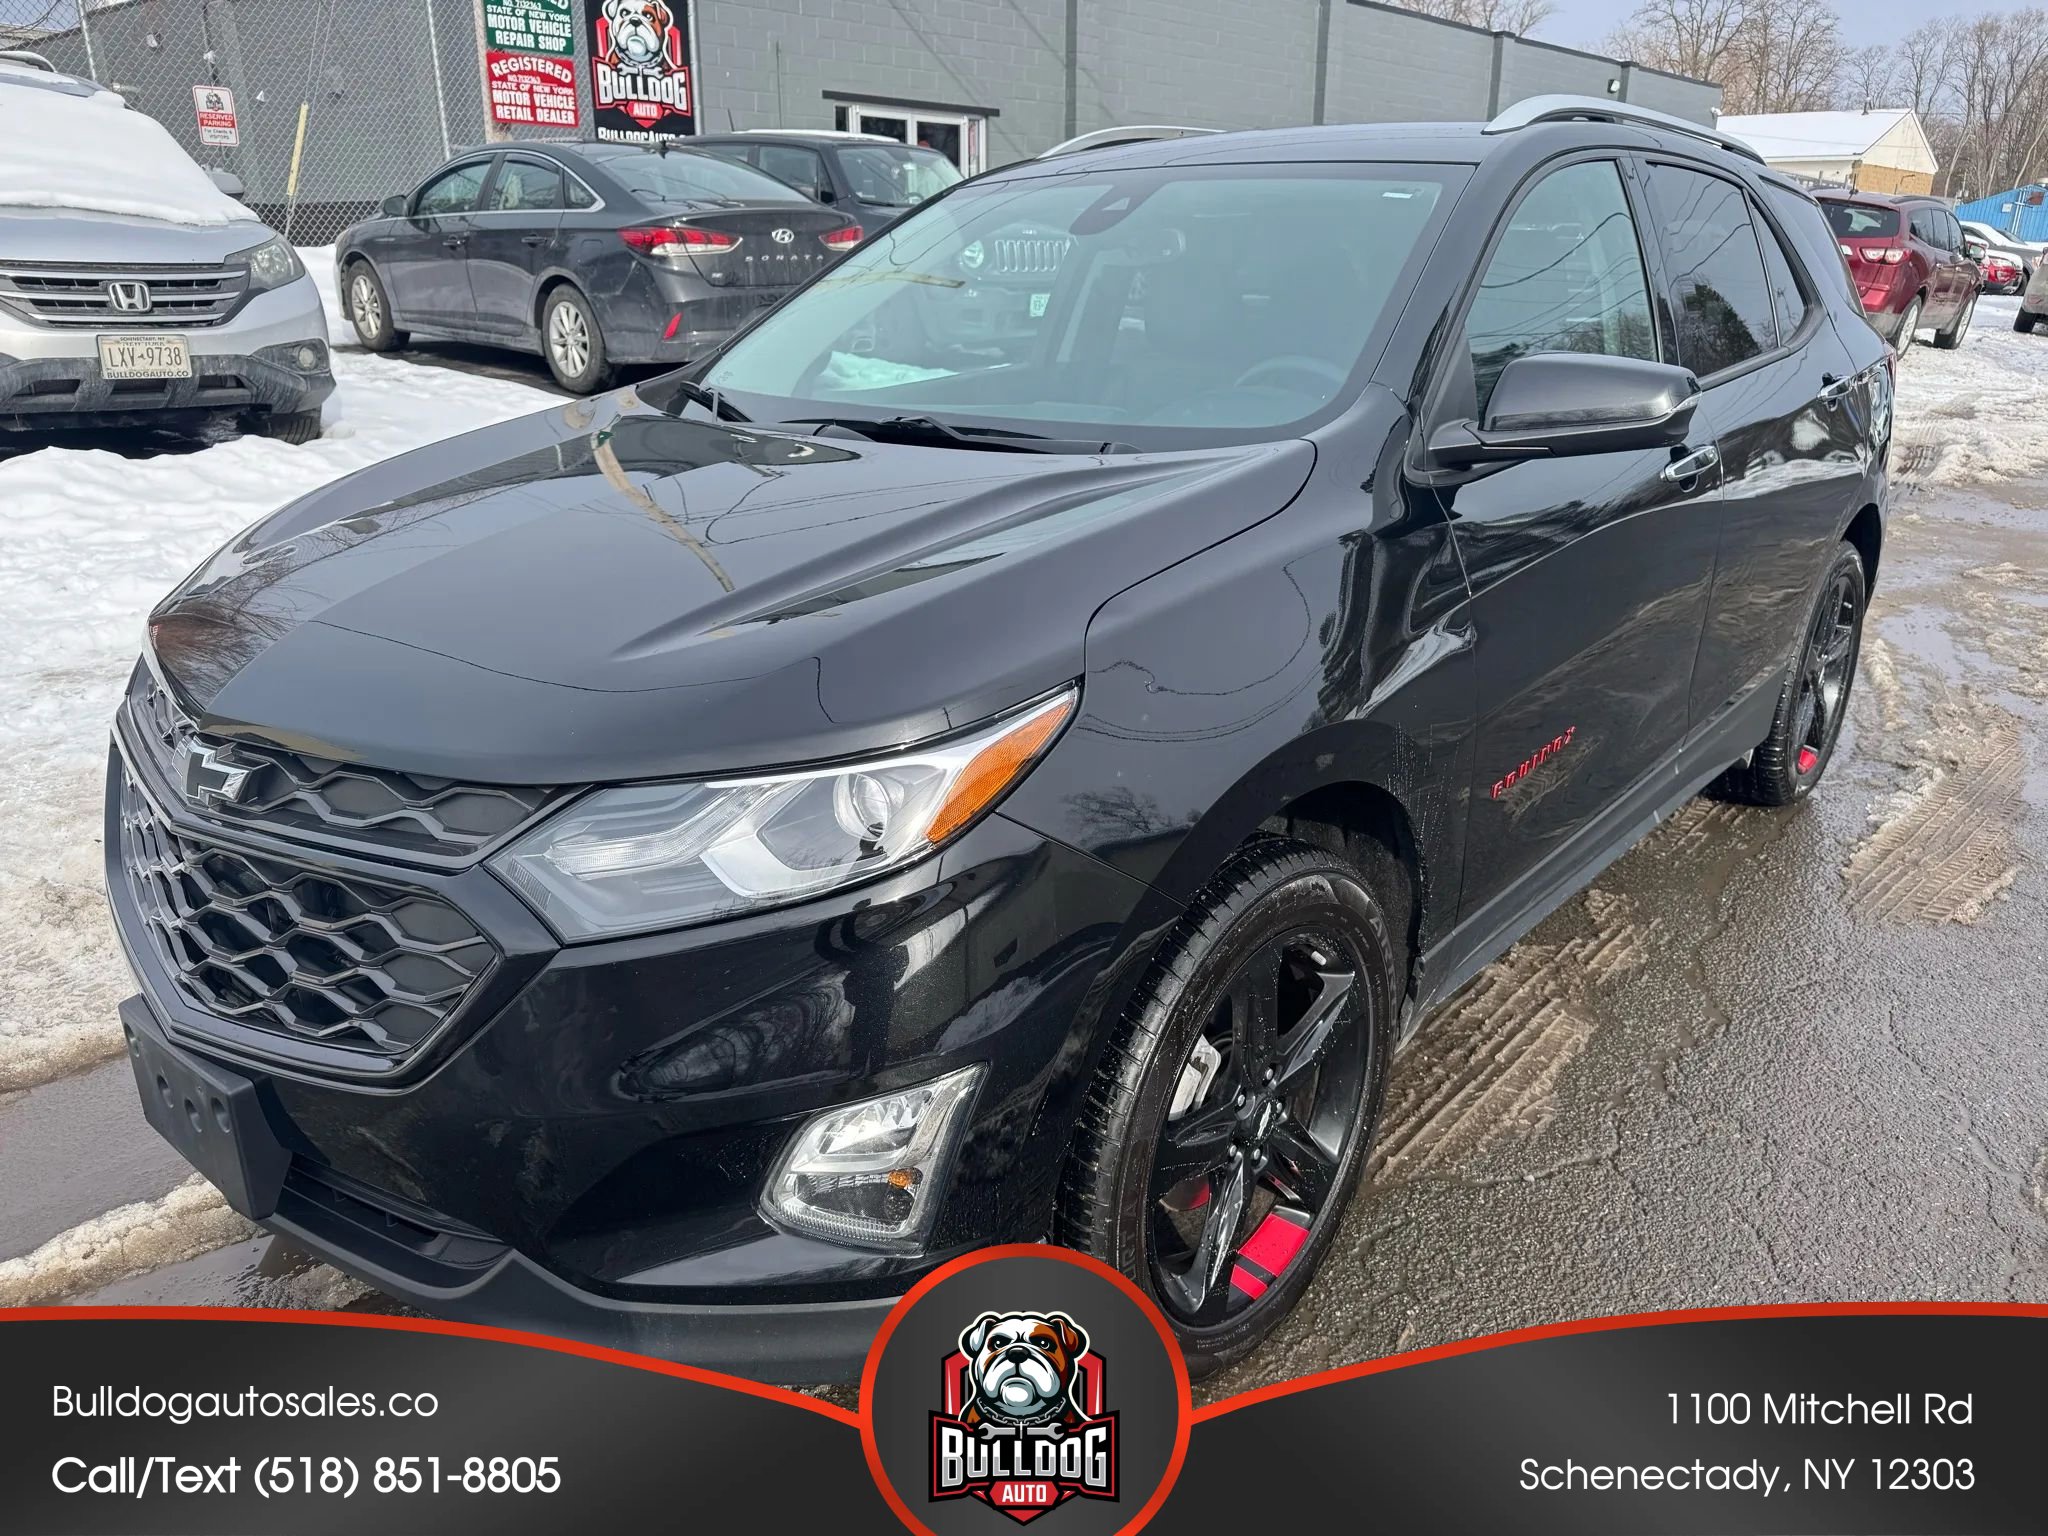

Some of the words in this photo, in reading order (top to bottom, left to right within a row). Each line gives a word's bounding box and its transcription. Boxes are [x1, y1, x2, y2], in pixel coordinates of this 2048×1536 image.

[486, 4, 513, 15] STATE
[515, 8, 526, 17] OF
[529, 10, 546, 19] NEW
[548, 12, 571, 23] YORK
[487, 13, 526, 32] MOTOR
[529, 18, 572, 37] VEHICLE
[495, 29, 535, 48] REPAIR
[538, 35, 567, 52] SHOP
[490, 57, 572, 83] REGISTERED
[491, 80, 517, 91] STATE
[519, 83, 531, 92] OF
[533, 84, 551, 93] NEW
[552, 86, 574, 96] YORK
[596, 62, 688, 112] BULLDOG
[492, 89, 531, 106] MOTOR
[533, 92, 576, 111] VEHICLE
[632, 102, 658, 117] AUTO
[496, 104, 534, 121] RETAIL
[536, 107, 575, 125] DEALER
[108, 347, 135, 368] LXV
[146, 346, 182, 366] 9738
[107, 371, 188, 379] BULLDOGAUTO.CO
[1489, 726, 1577, 800] EQUINOX
